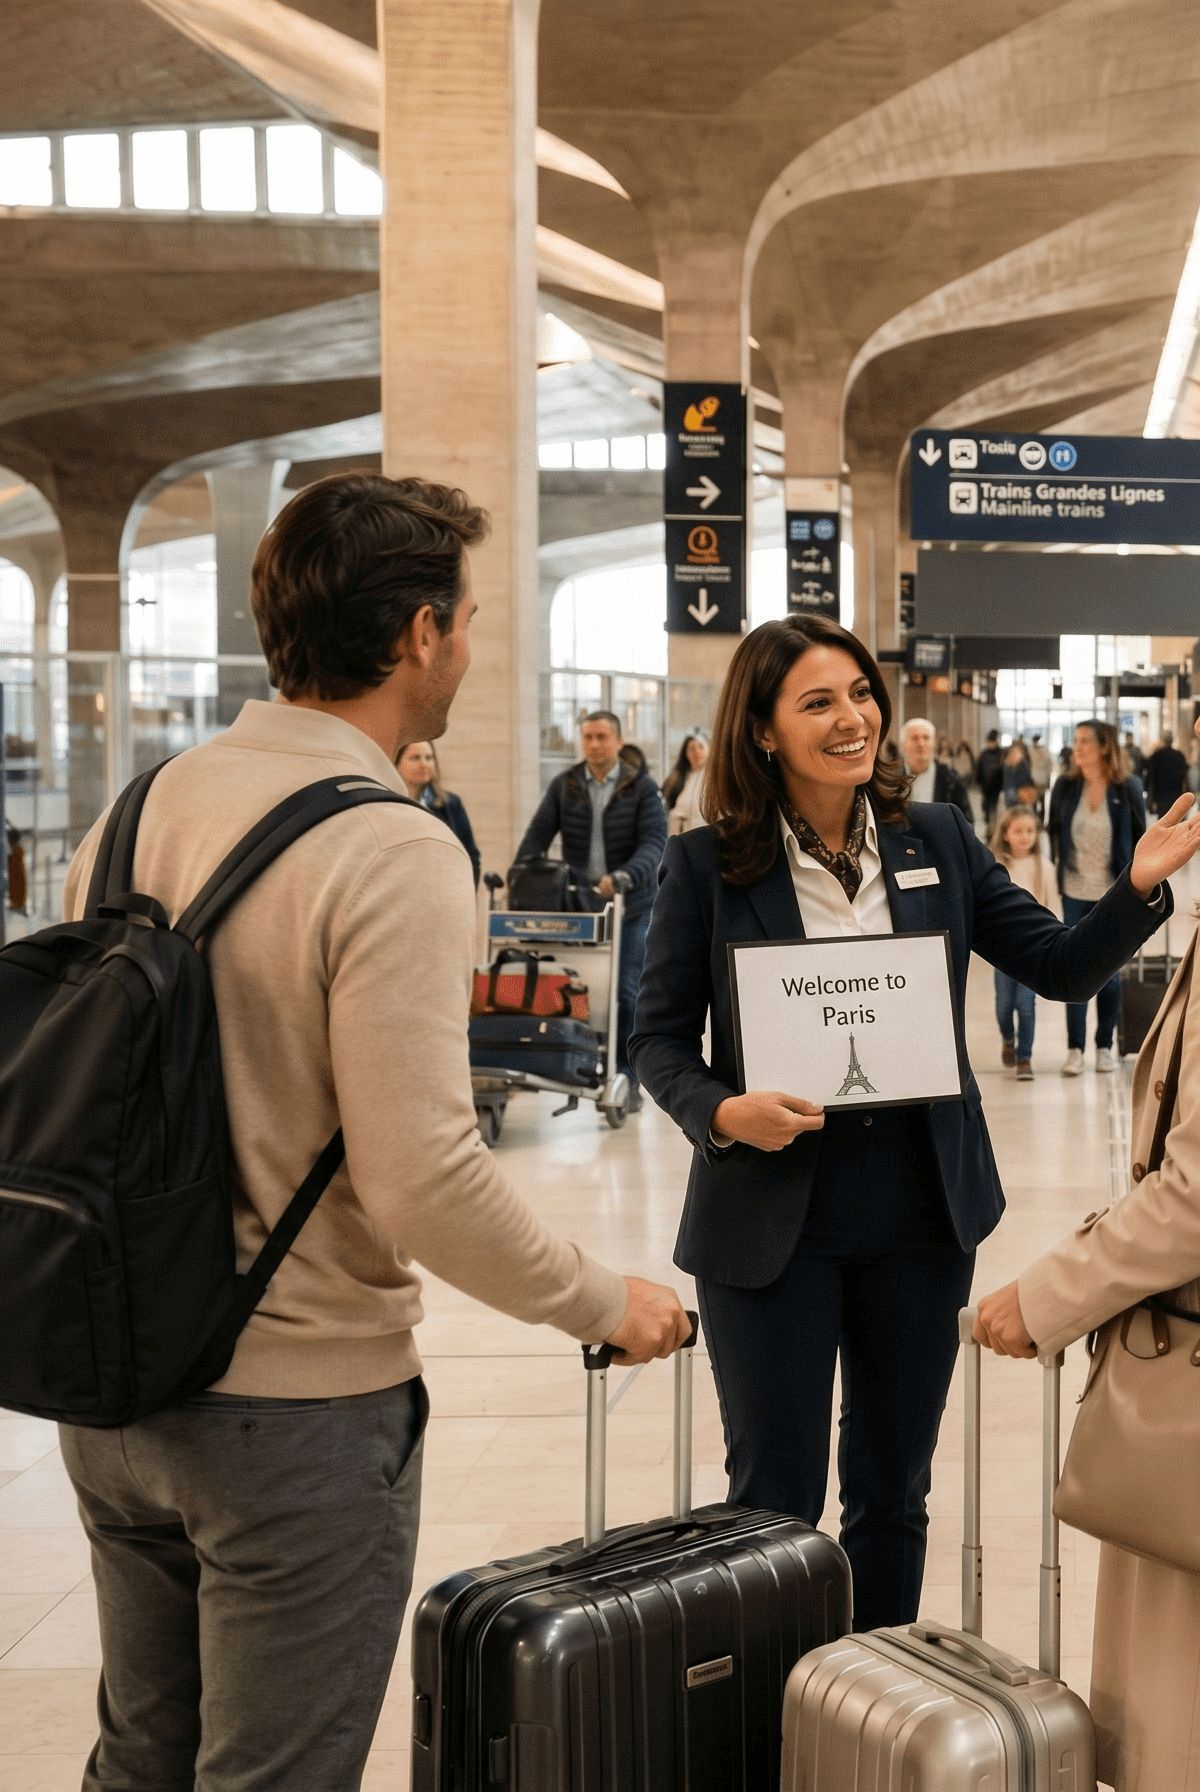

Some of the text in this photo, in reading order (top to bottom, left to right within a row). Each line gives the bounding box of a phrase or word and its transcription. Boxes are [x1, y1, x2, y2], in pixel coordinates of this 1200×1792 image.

[980, 482, 1166, 506] Trains Grandes Lignes
[980, 499, 1106, 519] Mainline trains
[781, 973, 906, 997] Welcome to
[822, 1004, 876, 1027] Paris
